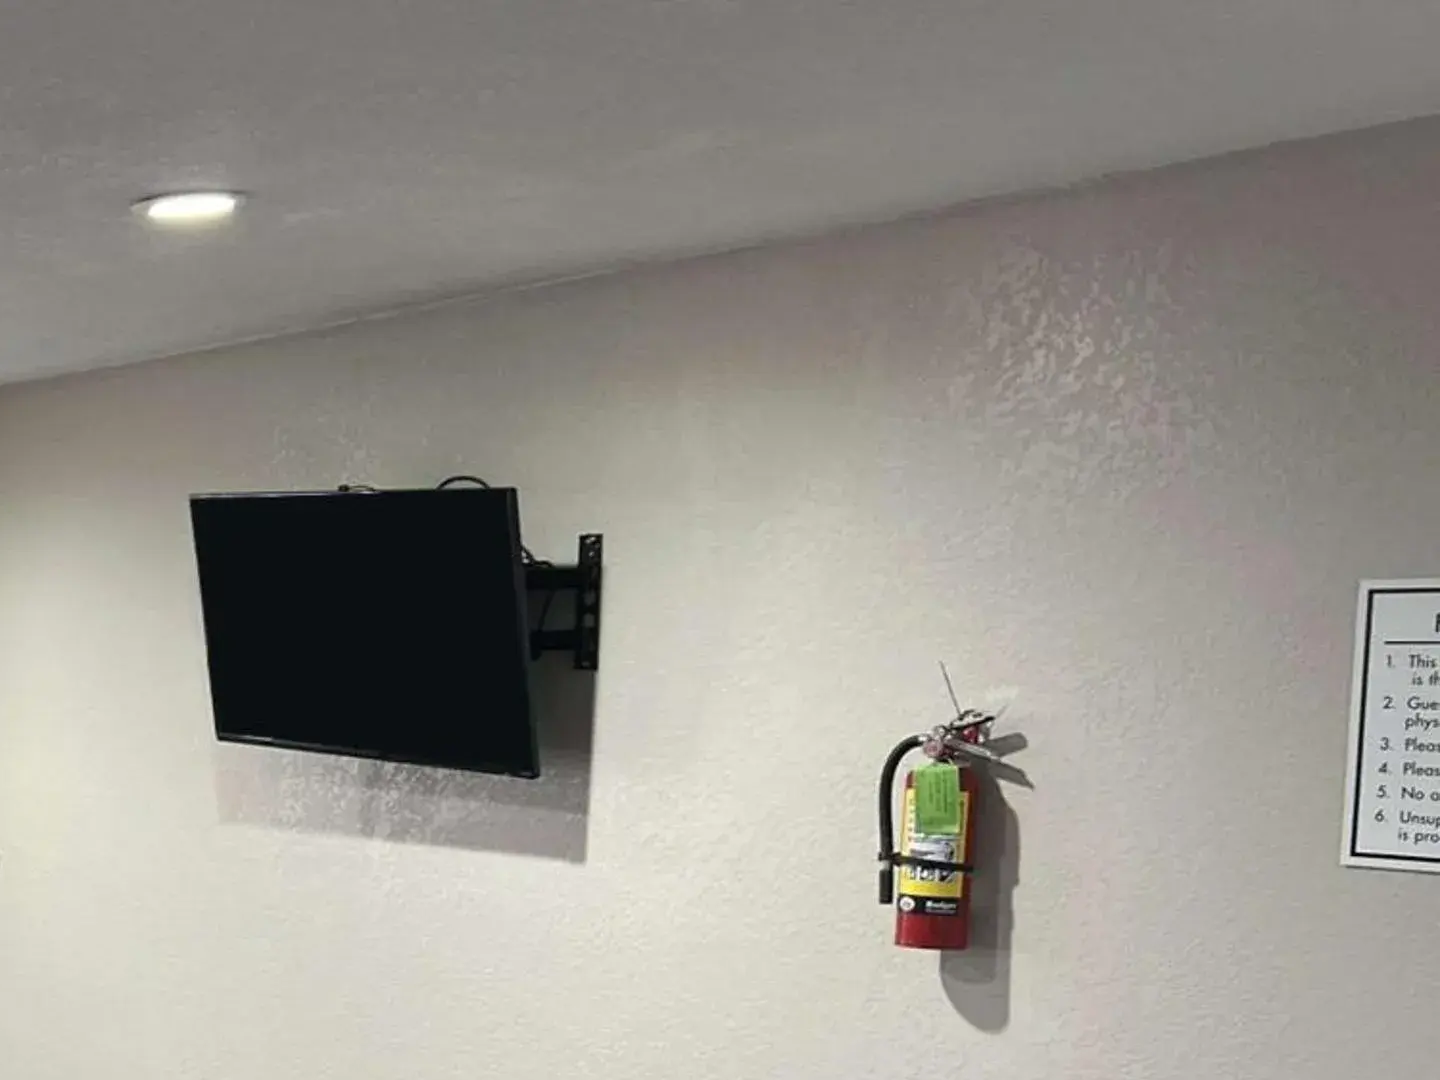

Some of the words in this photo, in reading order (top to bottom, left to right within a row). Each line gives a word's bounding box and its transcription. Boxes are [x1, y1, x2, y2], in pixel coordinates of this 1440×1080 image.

[1408, 653, 1437, 668] This
[1412, 672, 1423, 686] is
[1382, 695, 1396, 709] 2.
[1407, 696, 1440, 710] Gue
[1380, 736, 1394, 751] 3.
[1378, 761, 1392, 775] 4.
[1376, 784, 1390, 798] 5.
[1401, 786, 1425, 801] No
[1374, 808, 1388, 823] 6.
[1398, 827, 1408, 841] is
